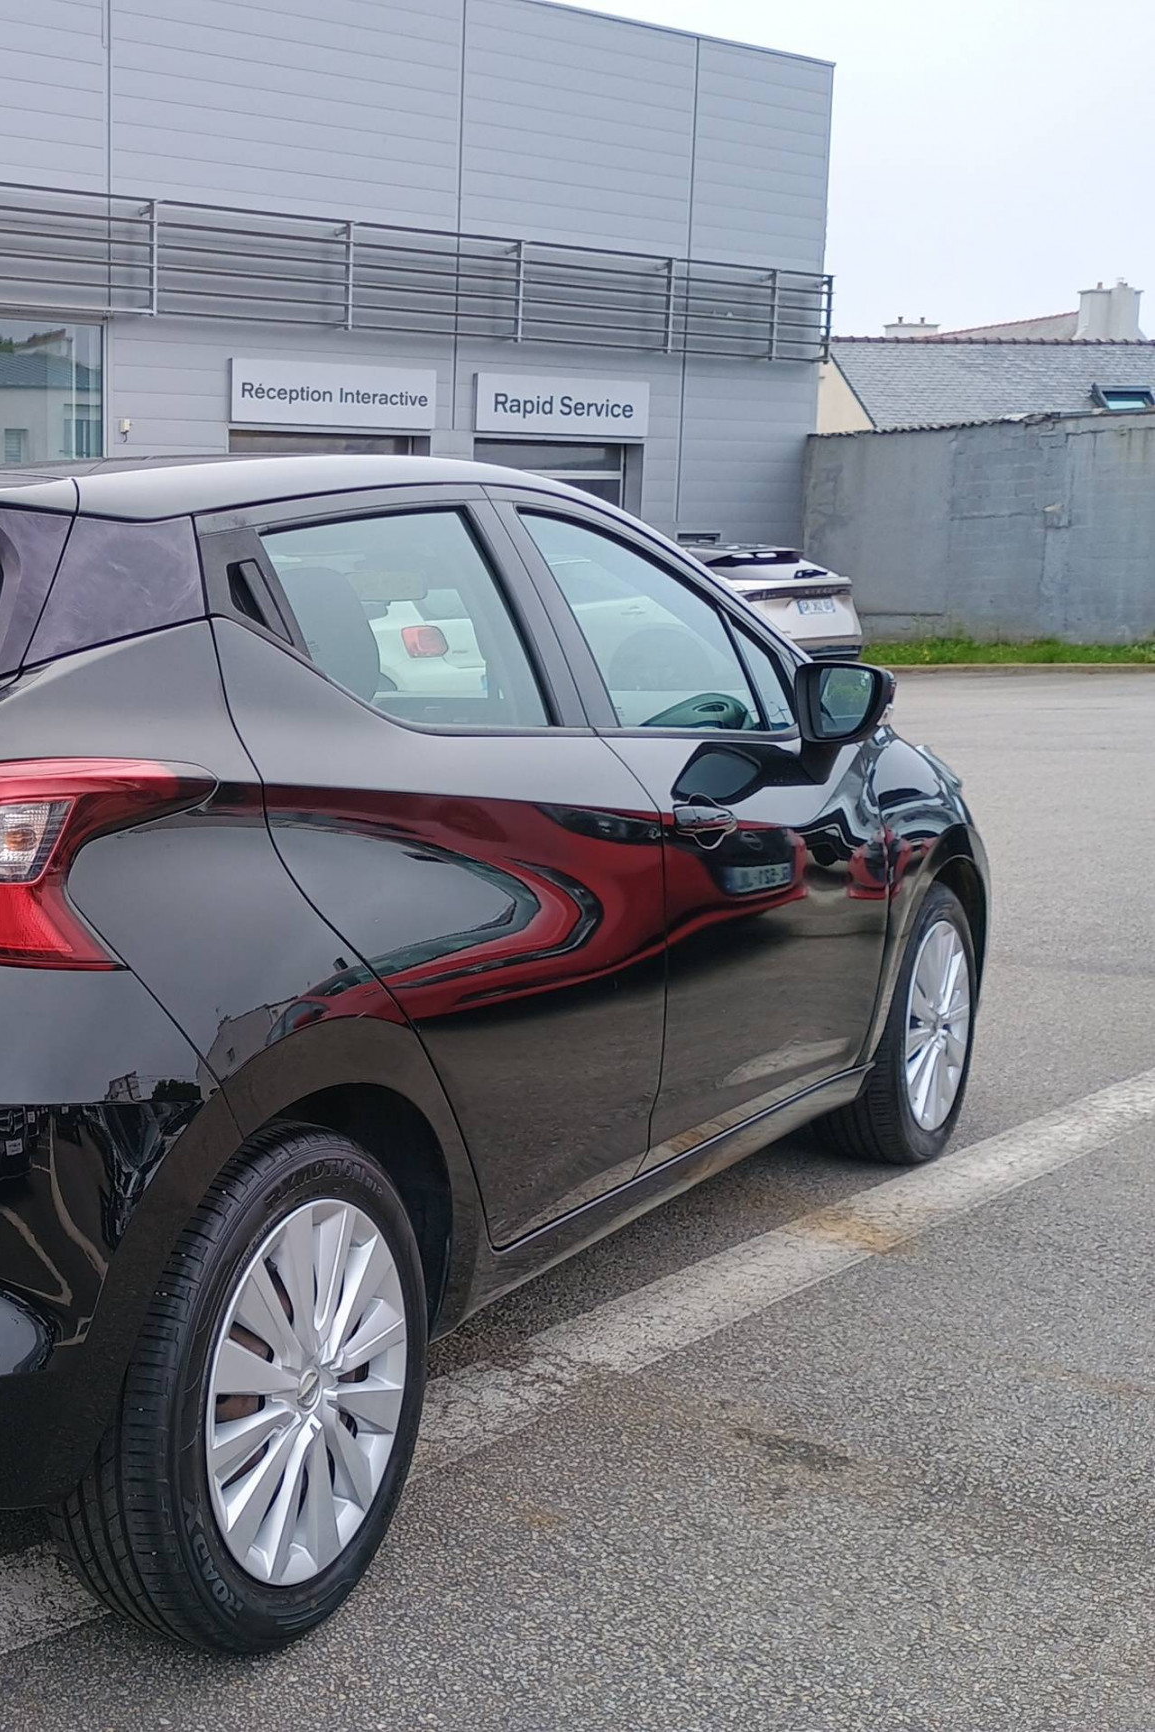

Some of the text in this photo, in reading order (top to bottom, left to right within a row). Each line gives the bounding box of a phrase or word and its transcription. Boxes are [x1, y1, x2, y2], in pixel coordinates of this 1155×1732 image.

[240, 382, 429, 408] Réception Interactive
[493, 392, 635, 419] Rapid Service
